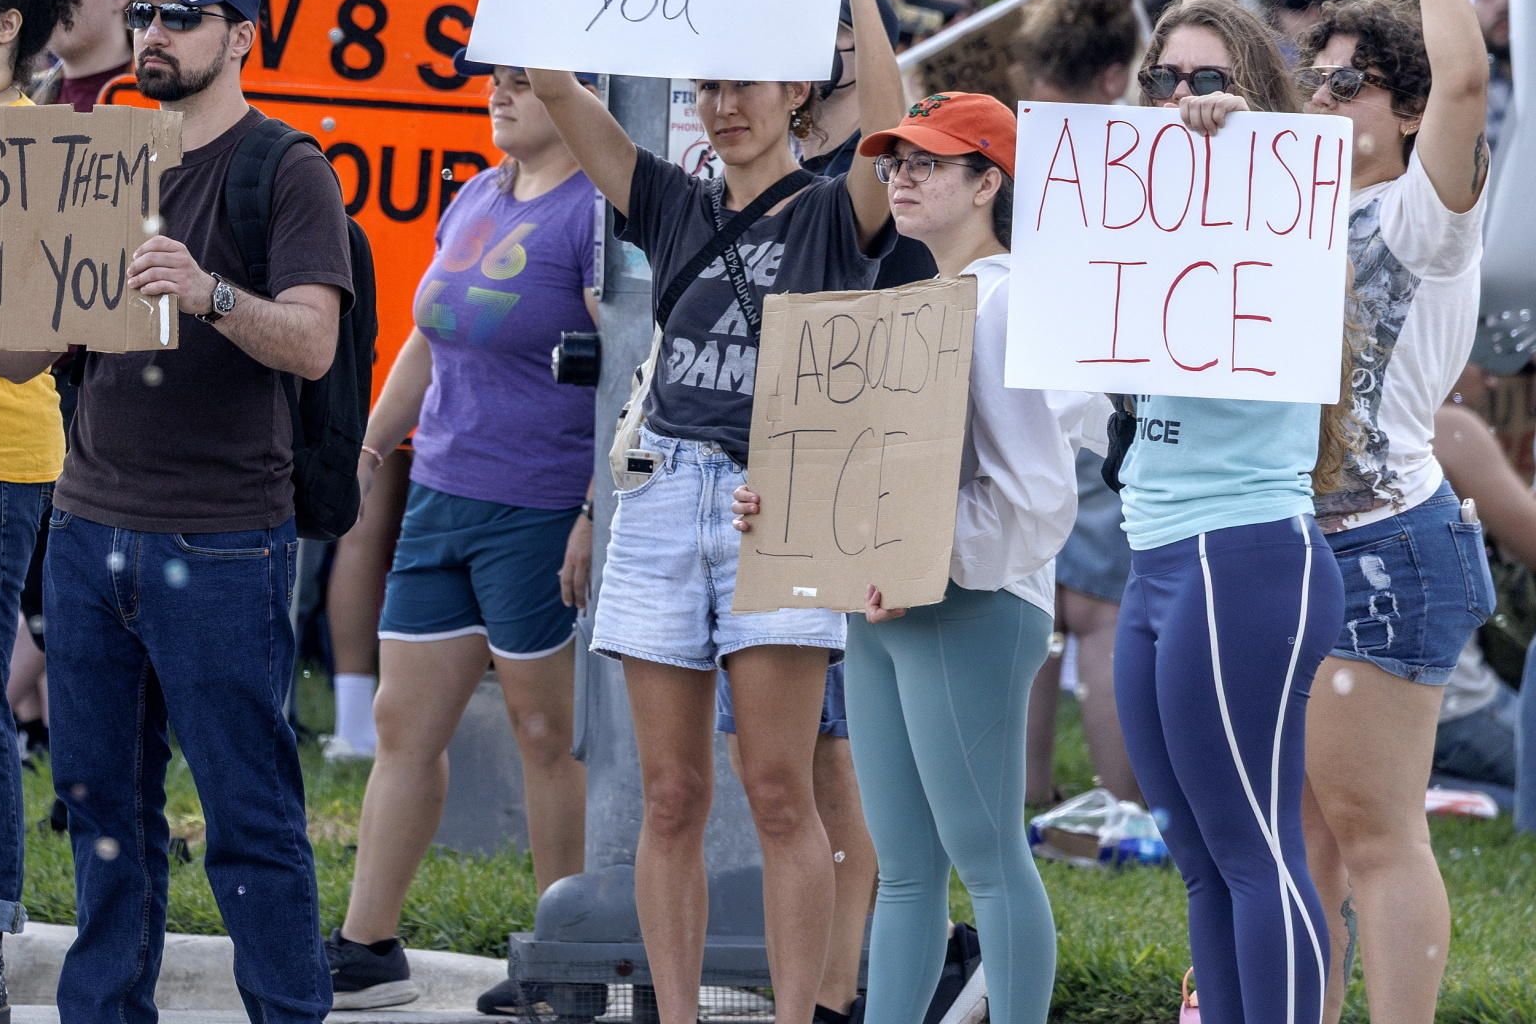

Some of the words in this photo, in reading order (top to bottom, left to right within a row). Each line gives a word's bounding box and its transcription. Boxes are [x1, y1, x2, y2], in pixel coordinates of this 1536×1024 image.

[51, 133, 152, 221] THEM
[1036, 118, 1344, 251] ABOLISH
[40, 233, 127, 334] YOU
[733, 273, 761, 326] HUMAN
[1075, 260, 1277, 377] ICE
[794, 303, 963, 406] ABOLISH
[756, 427, 909, 558] ICE
